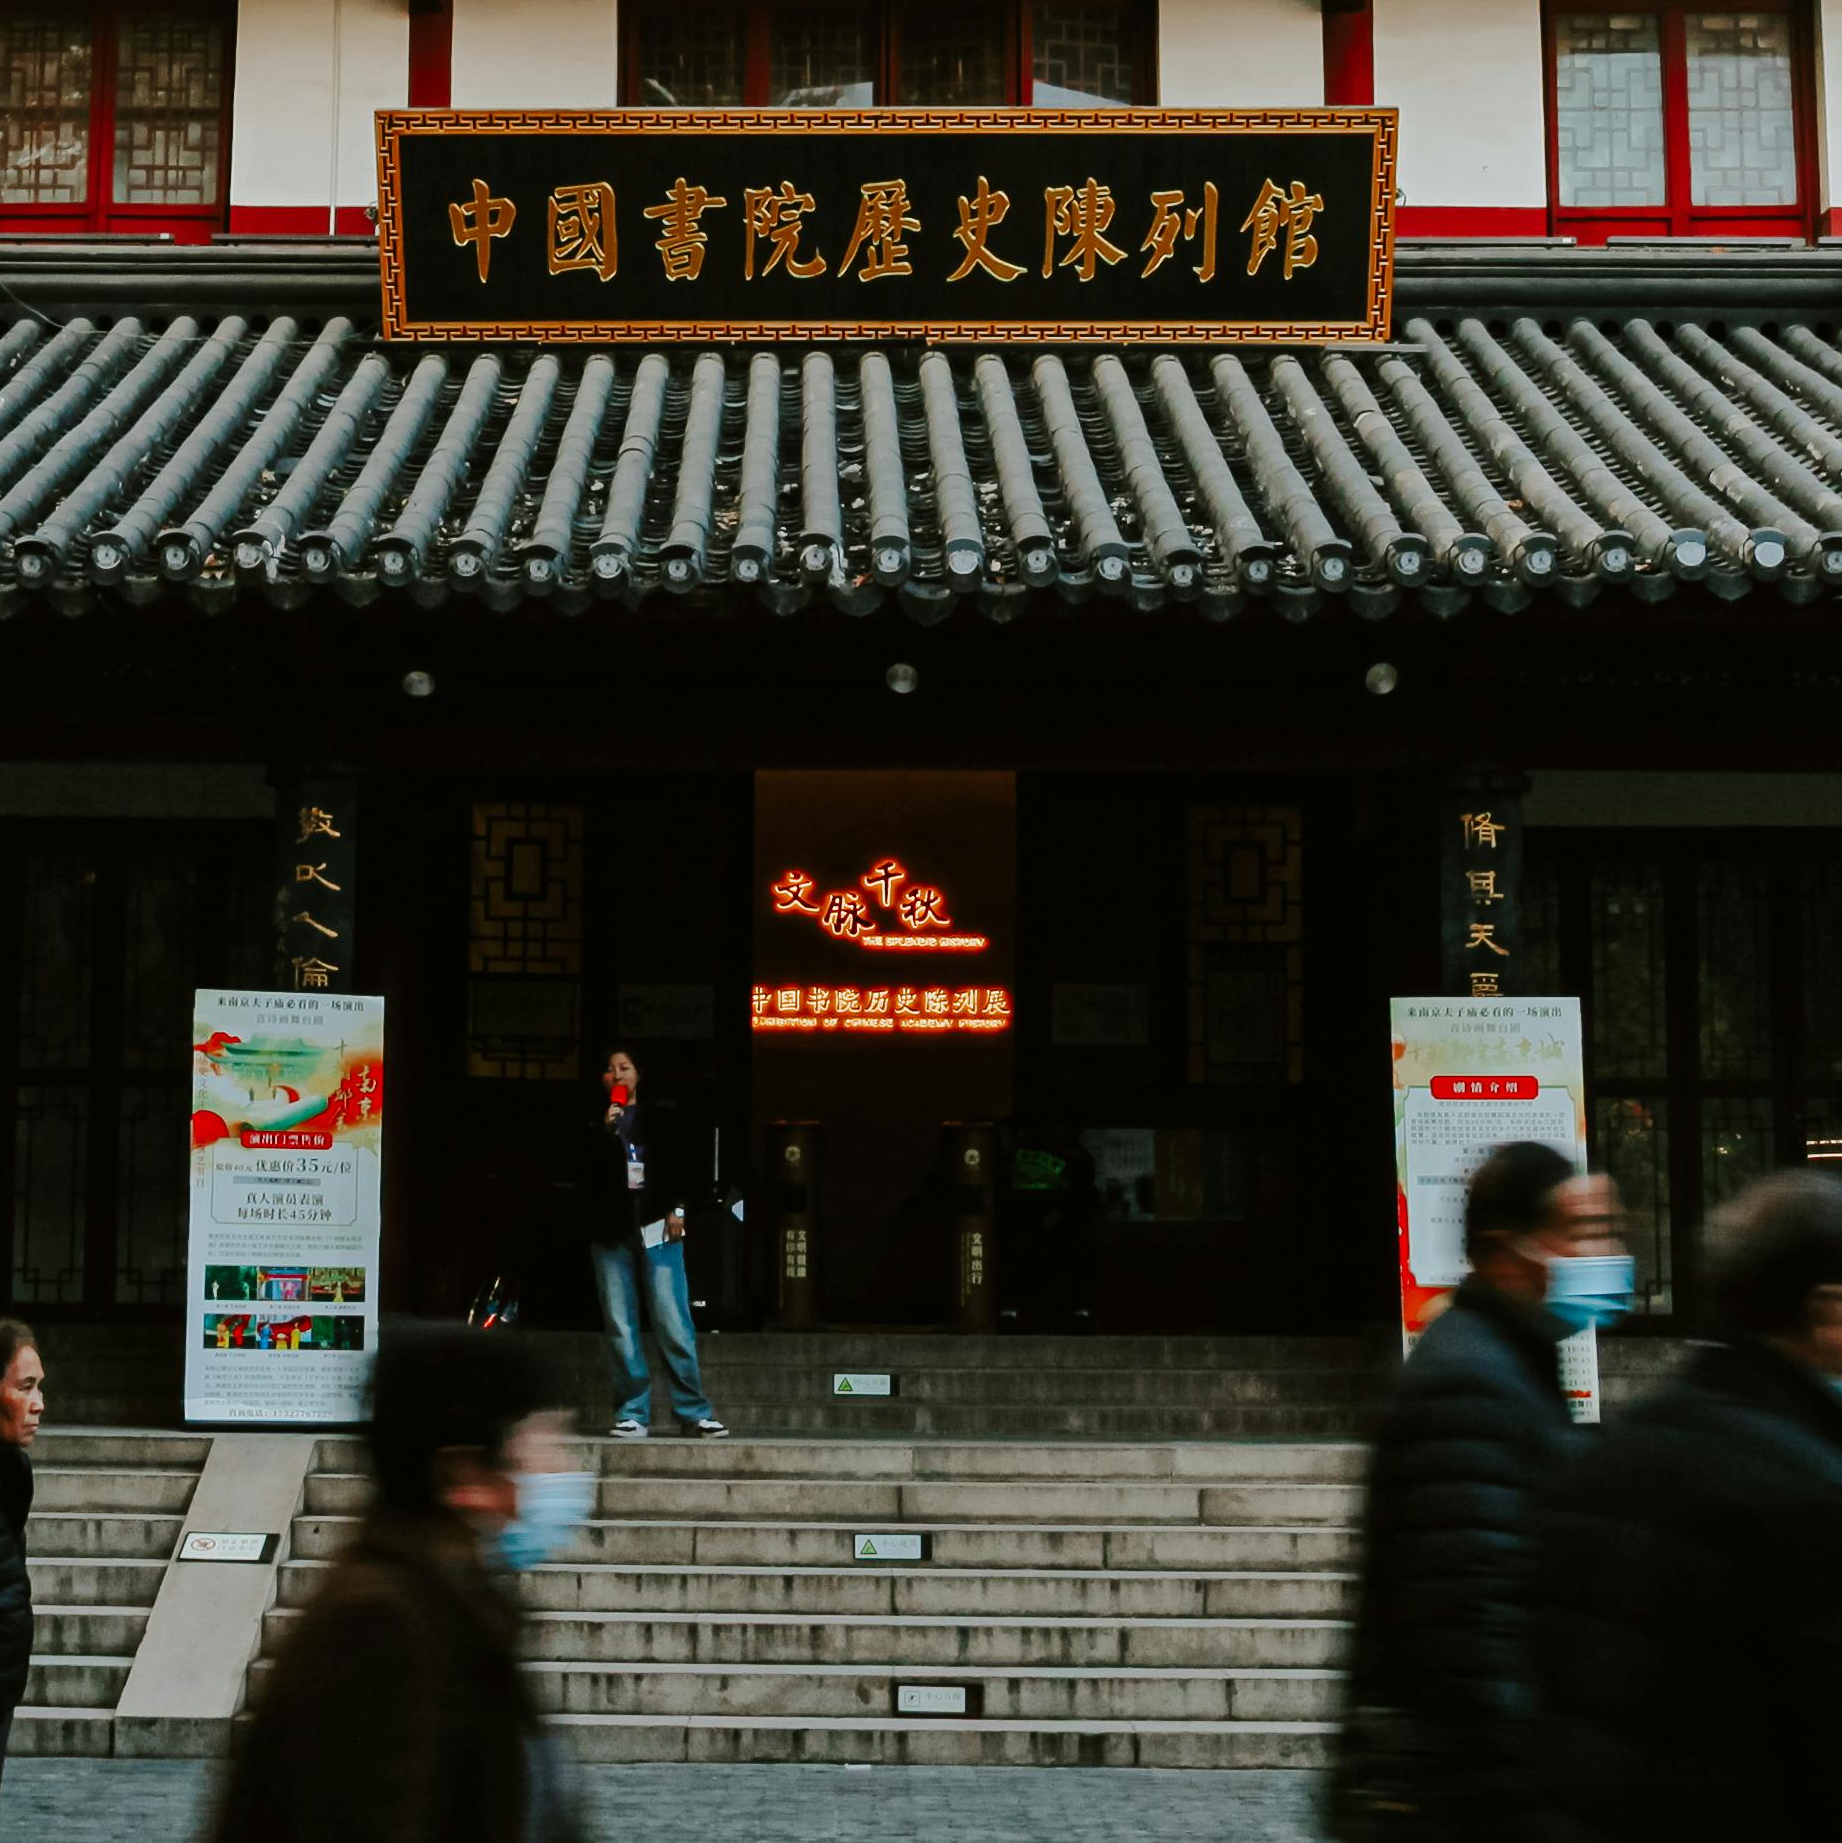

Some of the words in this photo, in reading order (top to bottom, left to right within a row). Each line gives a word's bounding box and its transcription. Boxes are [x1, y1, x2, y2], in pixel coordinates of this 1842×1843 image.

[774, 861, 950, 937] 文脉千秋
[862, 936, 883, 947] THE
[751, 987, 1010, 1014] 中国书院历史陈列展
[245, 1192, 325, 1206] 真人演员表演
[237, 1208, 333, 1221] 每场时长45分钟
